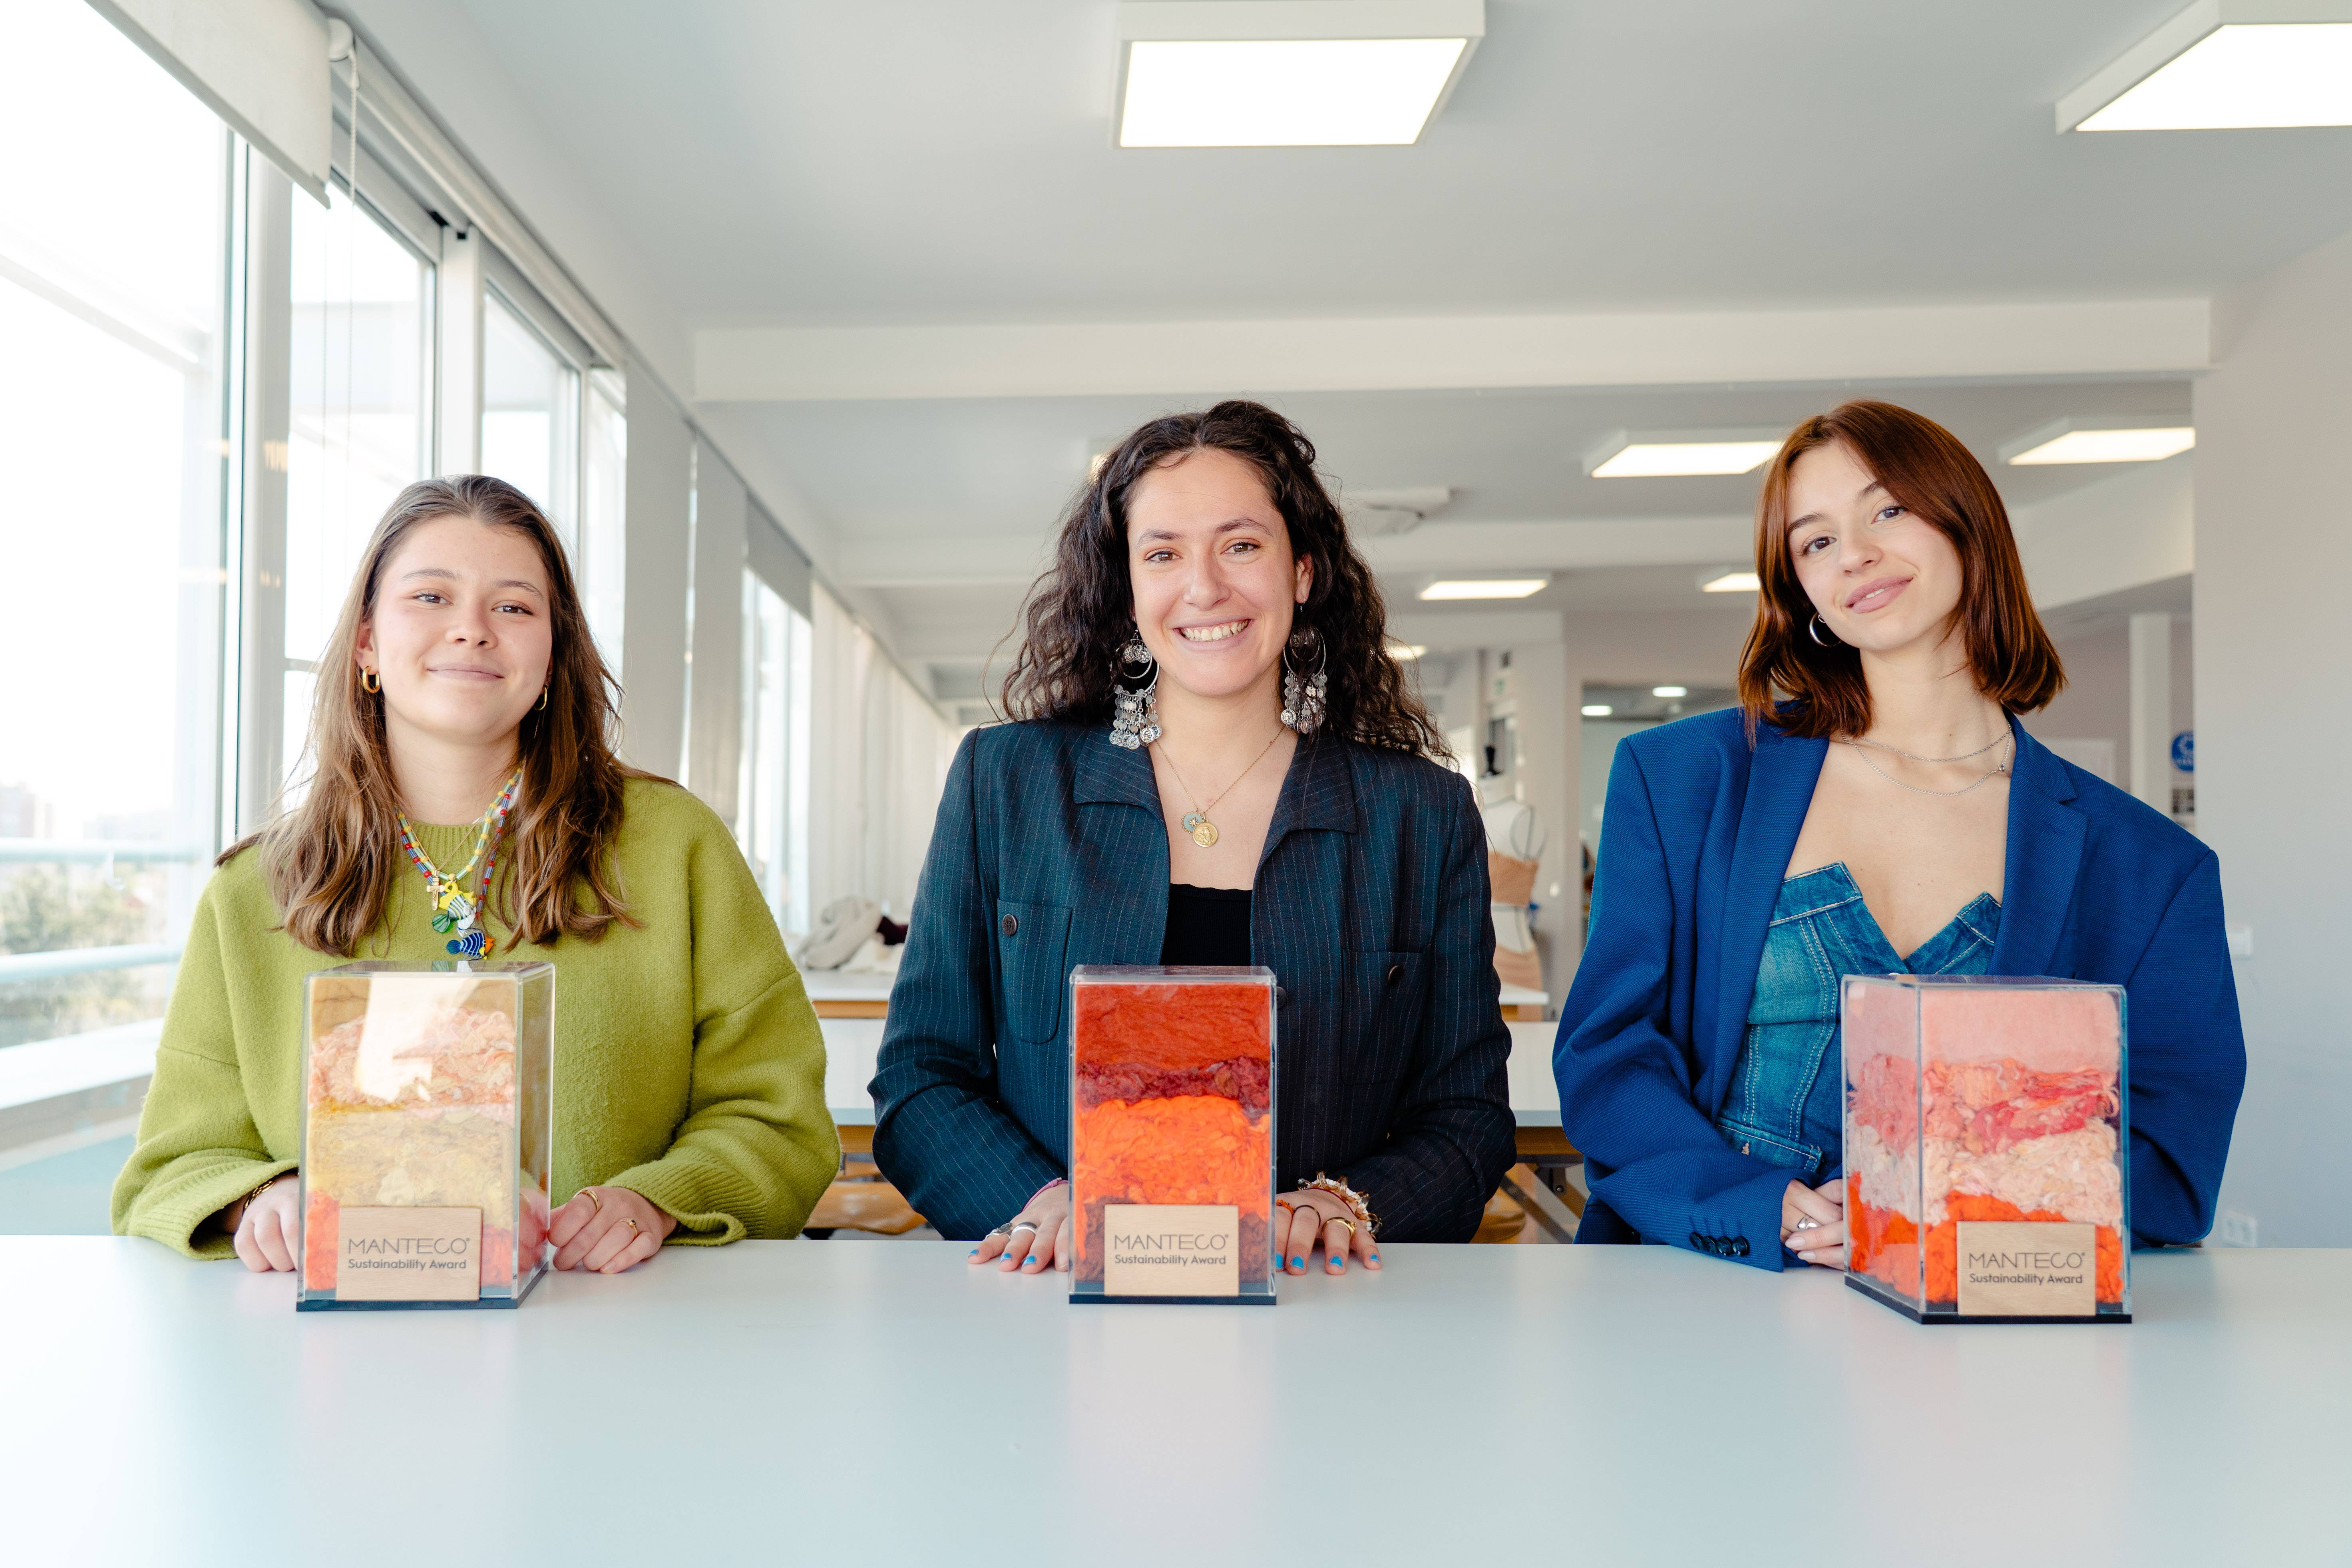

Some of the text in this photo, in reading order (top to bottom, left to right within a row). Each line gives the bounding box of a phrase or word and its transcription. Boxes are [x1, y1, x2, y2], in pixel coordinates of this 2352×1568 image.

[348, 1259, 466, 1271] Sustainability Award
[1114, 1254, 1226, 1266] Sustainability Award
[1969, 1273, 2083, 1285] Sustainability Award
